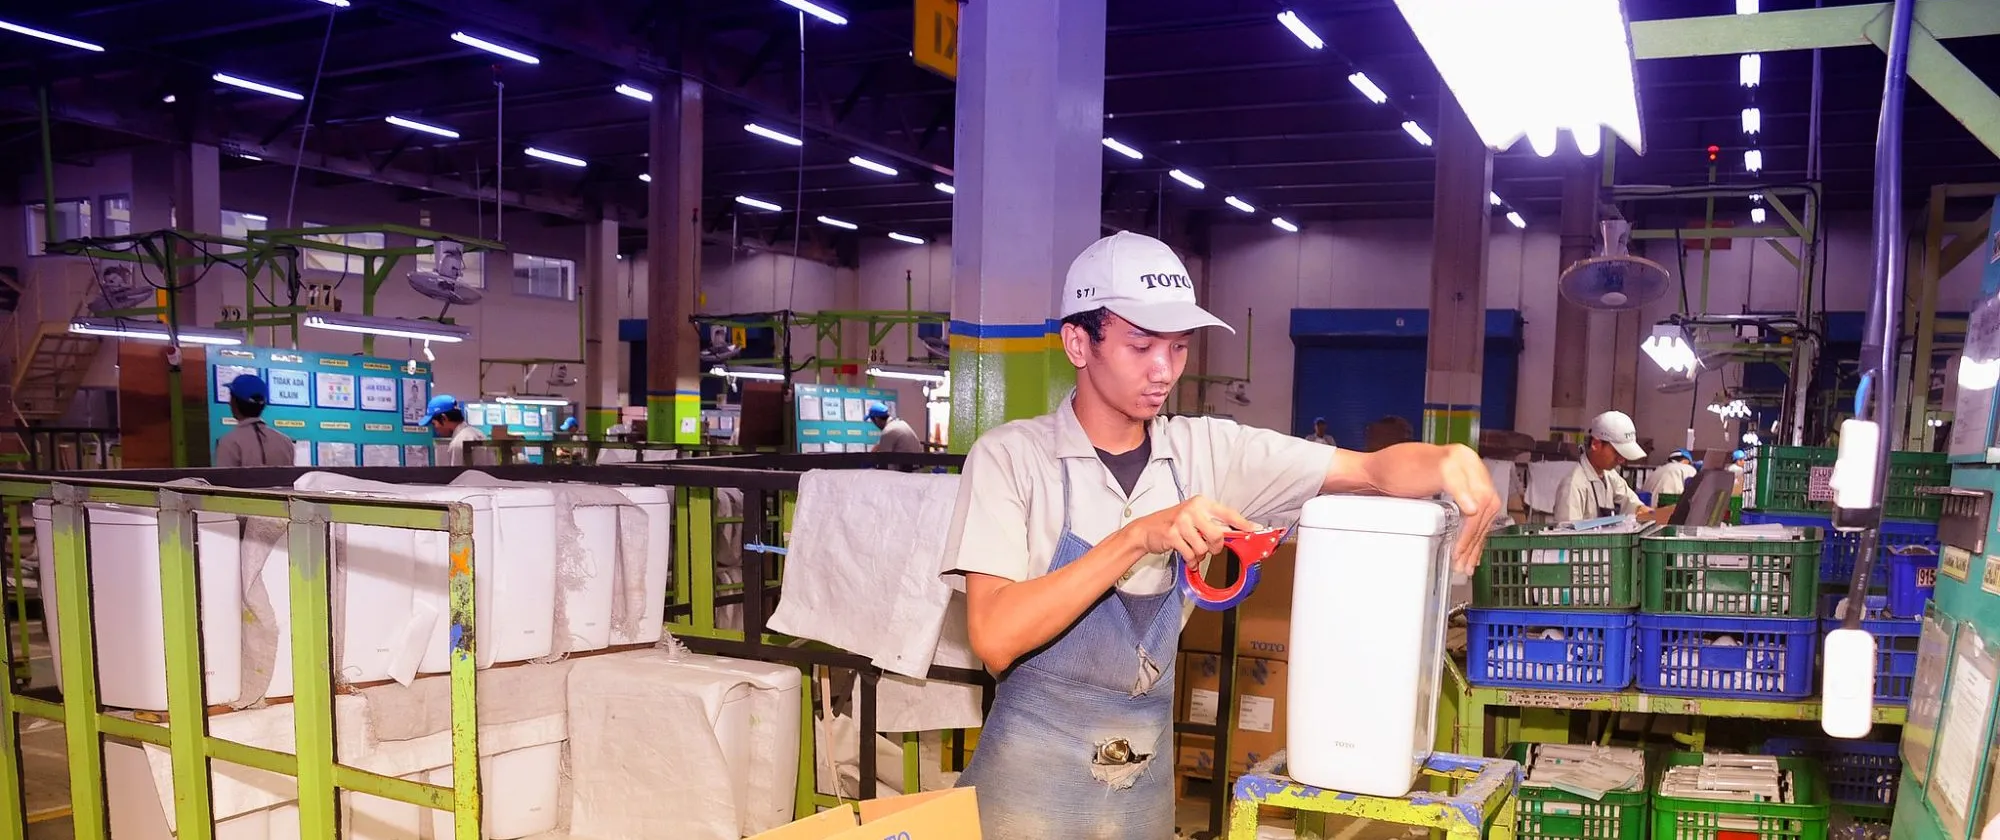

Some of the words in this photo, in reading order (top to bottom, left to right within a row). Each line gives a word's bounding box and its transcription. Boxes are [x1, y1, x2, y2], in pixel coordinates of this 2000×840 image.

[1140, 273, 1192, 290] TOTO
[1076, 287, 1096, 299] STI
[273, 376, 291, 385] TIDAK
[292, 379, 304, 387] ADA
[279, 391, 299, 399] KLAIM
[1250, 640, 1285, 653] TOTO
[1334, 741, 1356, 749] TOTO
